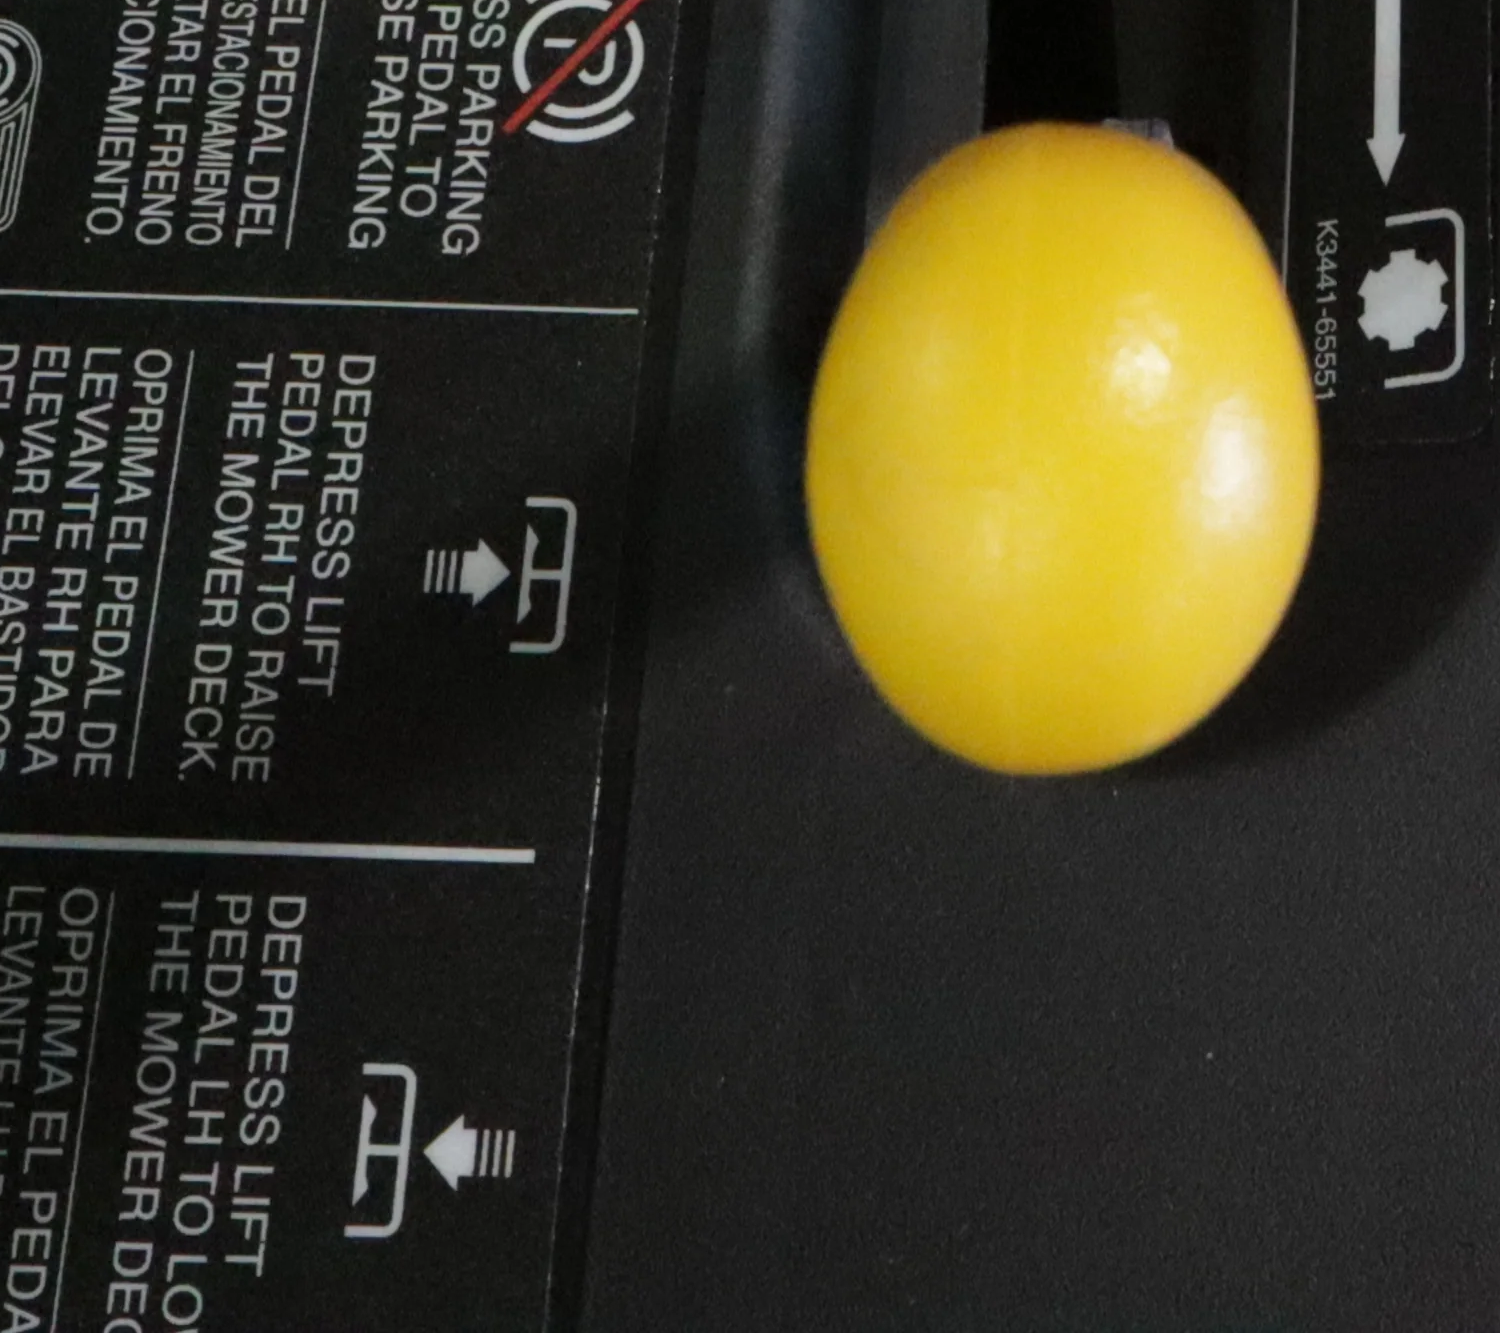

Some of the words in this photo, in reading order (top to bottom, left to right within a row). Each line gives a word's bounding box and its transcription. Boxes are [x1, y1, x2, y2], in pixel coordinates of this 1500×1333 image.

[155, 73, 197, 115] EL
[247, 44, 301, 166] PEDAL
[408, 4, 464, 147] PEDAL
[134, 123, 189, 246] FRENO
[234, 174, 281, 249] DEL
[347, 55, 410, 250] PARKING
[398, 156, 443, 218] TO
[440, 63, 502, 256] PARKING
[1314, 218, 1340, 401] K3441-65551
[11, 344, 72, 494] ELEVAR
[54, 346, 123, 552] LEVANTE
[113, 348, 174, 505] OPRIMA
[225, 352, 275, 439] THE
[270, 352, 326, 491] PEDAL
[310, 354, 377, 580] DEPRESS
[1, 507, 46, 556] EL
[104, 515, 149, 564] EL
[198, 452, 260, 628] MOWER
[260, 502, 305, 564] RH
[41, 566, 89, 632] RH
[82, 574, 140, 710] PEDAL
[251, 574, 296, 636] TO
[296, 596, 345, 698] LIFT
[19, 648, 76, 775] PARA
[72, 721, 118, 779] DE
[177, 642, 233, 781] DECK.
[230, 649, 286, 783] RAISE
[33, 886, 100, 1095] OPRIMA
[148, 889, 200, 994] THE
[193, 893, 254, 1065] PEDAL
[238, 895, 308, 1146] DEPRESS
[22, 1110, 69, 1175] EL
[117, 1011, 184, 1222] MOWER
[183, 1079, 231, 1145] LH
[172, 1161, 220, 1237] TO
[224, 1164, 275, 1278] LIFT
[161, 1253, 209, 1333] LO
